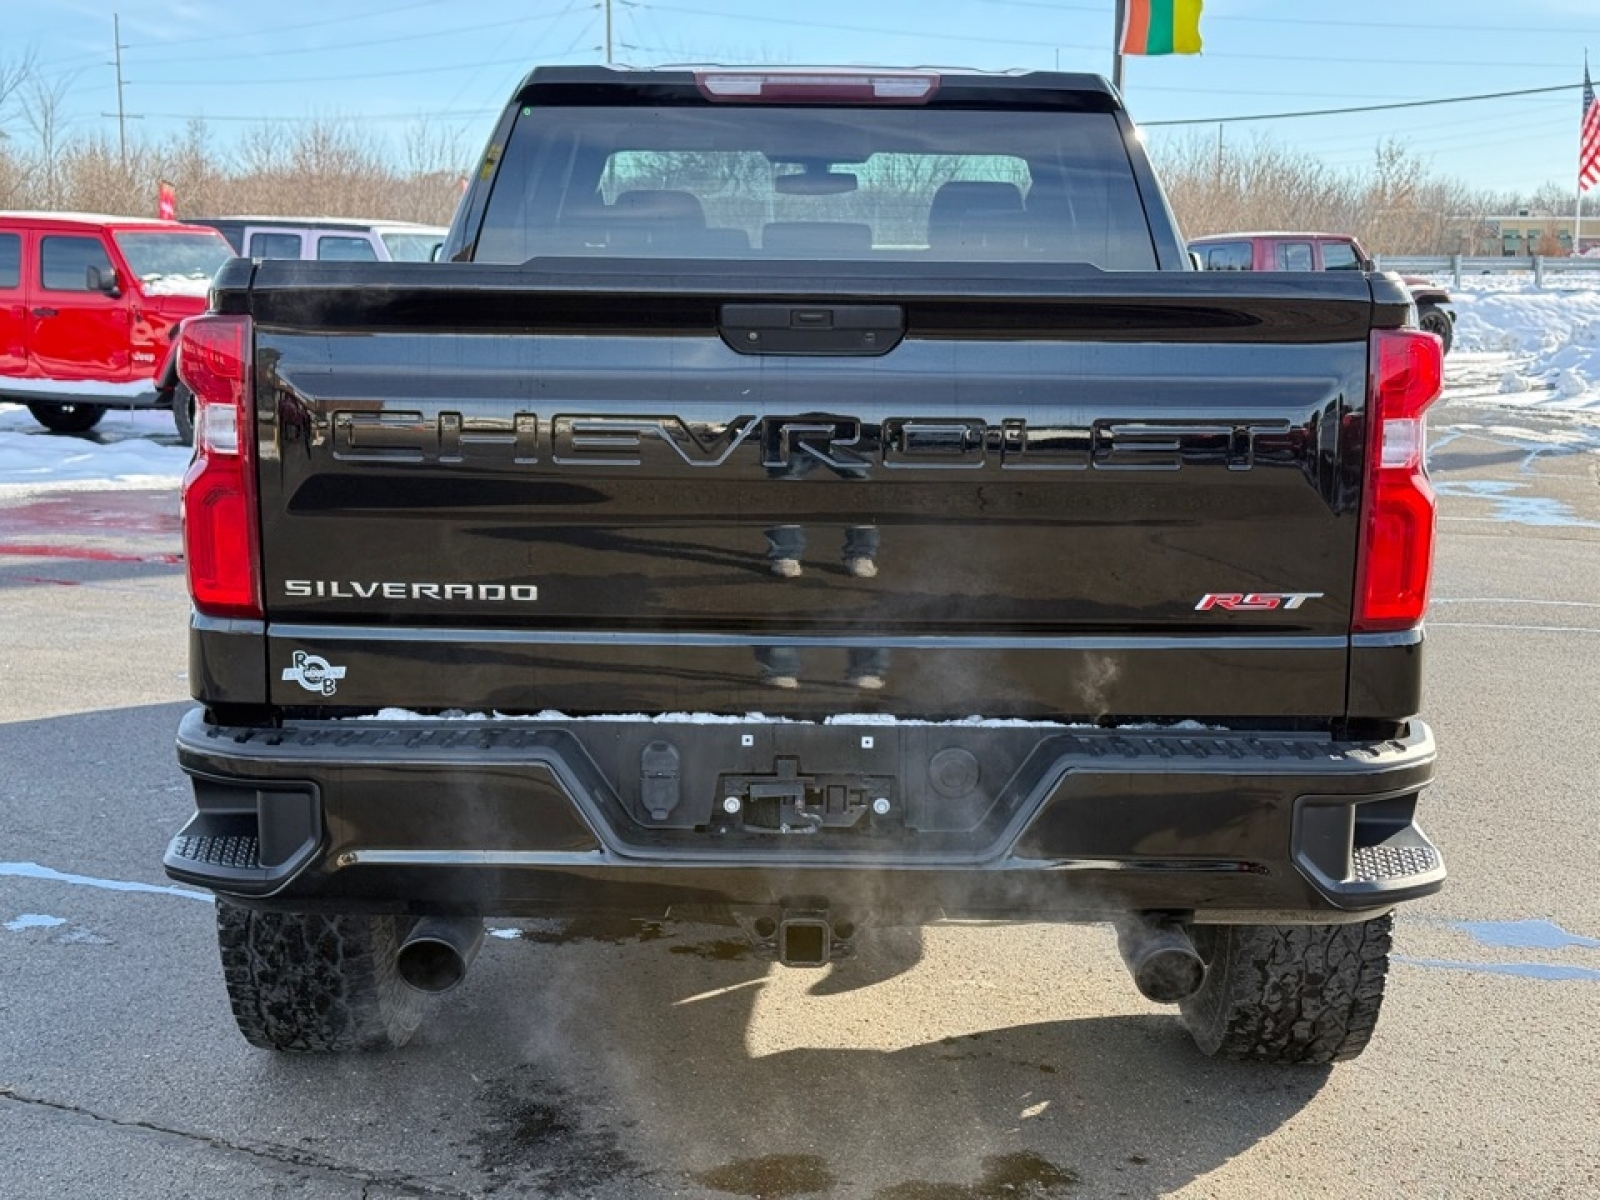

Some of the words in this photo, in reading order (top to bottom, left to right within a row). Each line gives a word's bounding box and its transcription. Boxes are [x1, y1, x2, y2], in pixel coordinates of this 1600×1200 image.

[332, 408, 1292, 472] CHEVROLET
[284, 579, 539, 601] SILVERADO
[1194, 592, 1325, 611] RST
